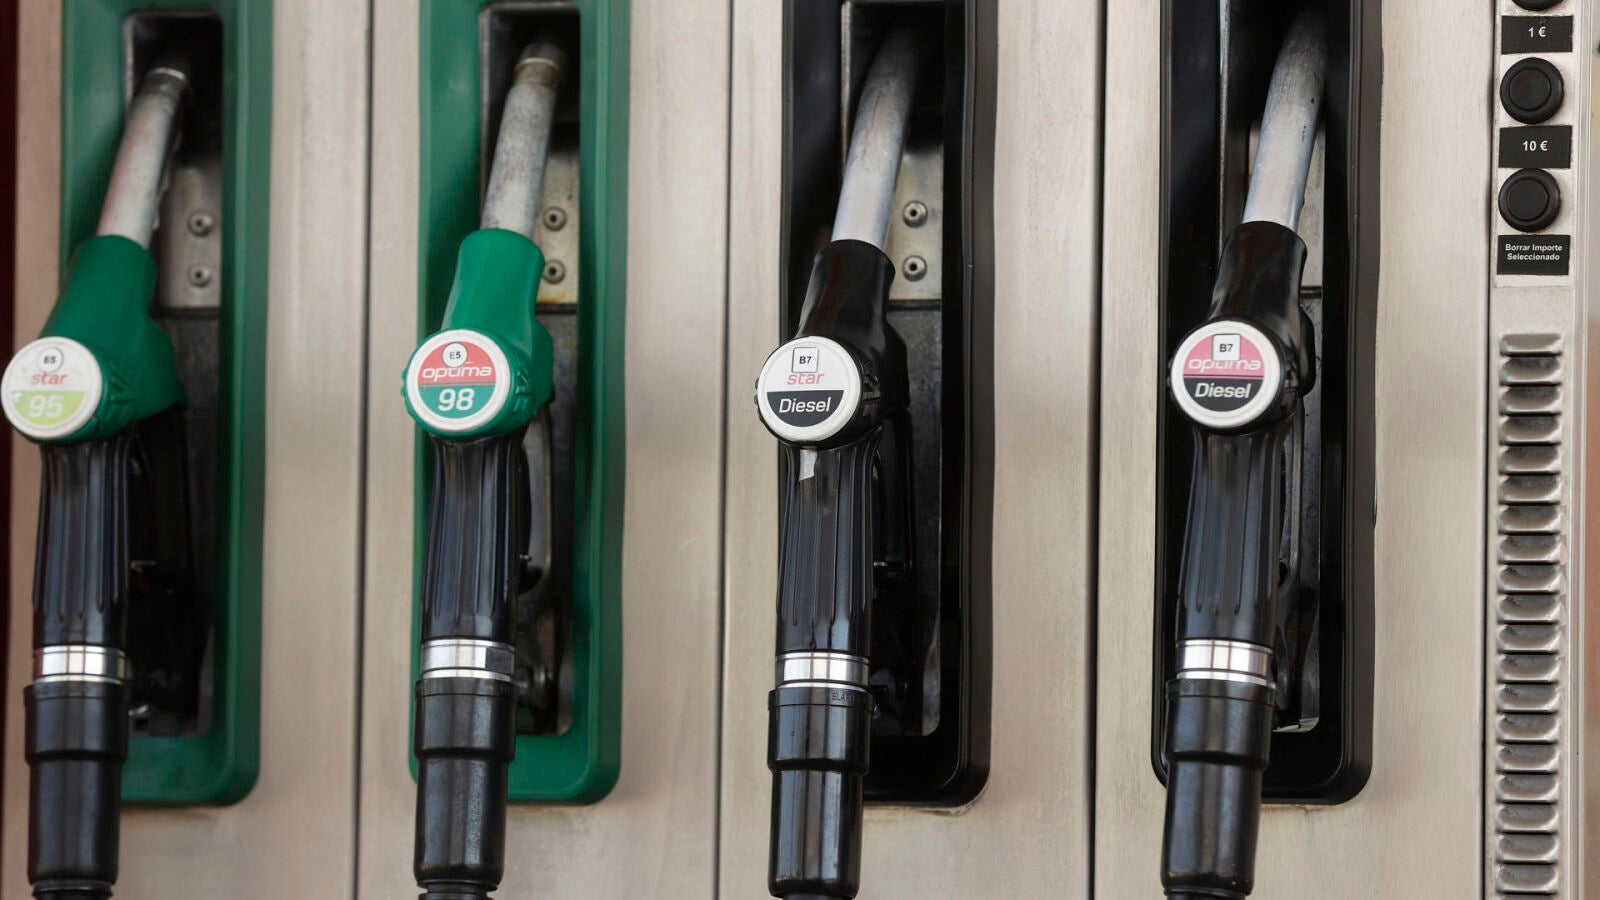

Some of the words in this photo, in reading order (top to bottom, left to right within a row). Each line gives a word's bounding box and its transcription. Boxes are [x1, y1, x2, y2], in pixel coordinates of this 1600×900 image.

[1528, 27, 1534, 38] 1
[1538, 26, 1547, 37] €
[1522, 140, 1537, 151] 10
[1540, 140, 1549, 151] €
[1505, 243, 1531, 251] Borrar
[1532, 244, 1563, 252] Importe
[1506, 252, 1560, 261] Seleccionado
[1219, 343, 1234, 353] B7
[449, 351, 462, 360] E5
[799, 355, 812, 365] B7
[422, 362, 492, 382] optima
[31, 372, 68, 385] star
[787, 372, 825, 385] star
[1194, 382, 1252, 399] Diesel
[438, 388, 475, 412] 98
[779, 397, 831, 413] Diesel
[28, 395, 64, 418] 95
